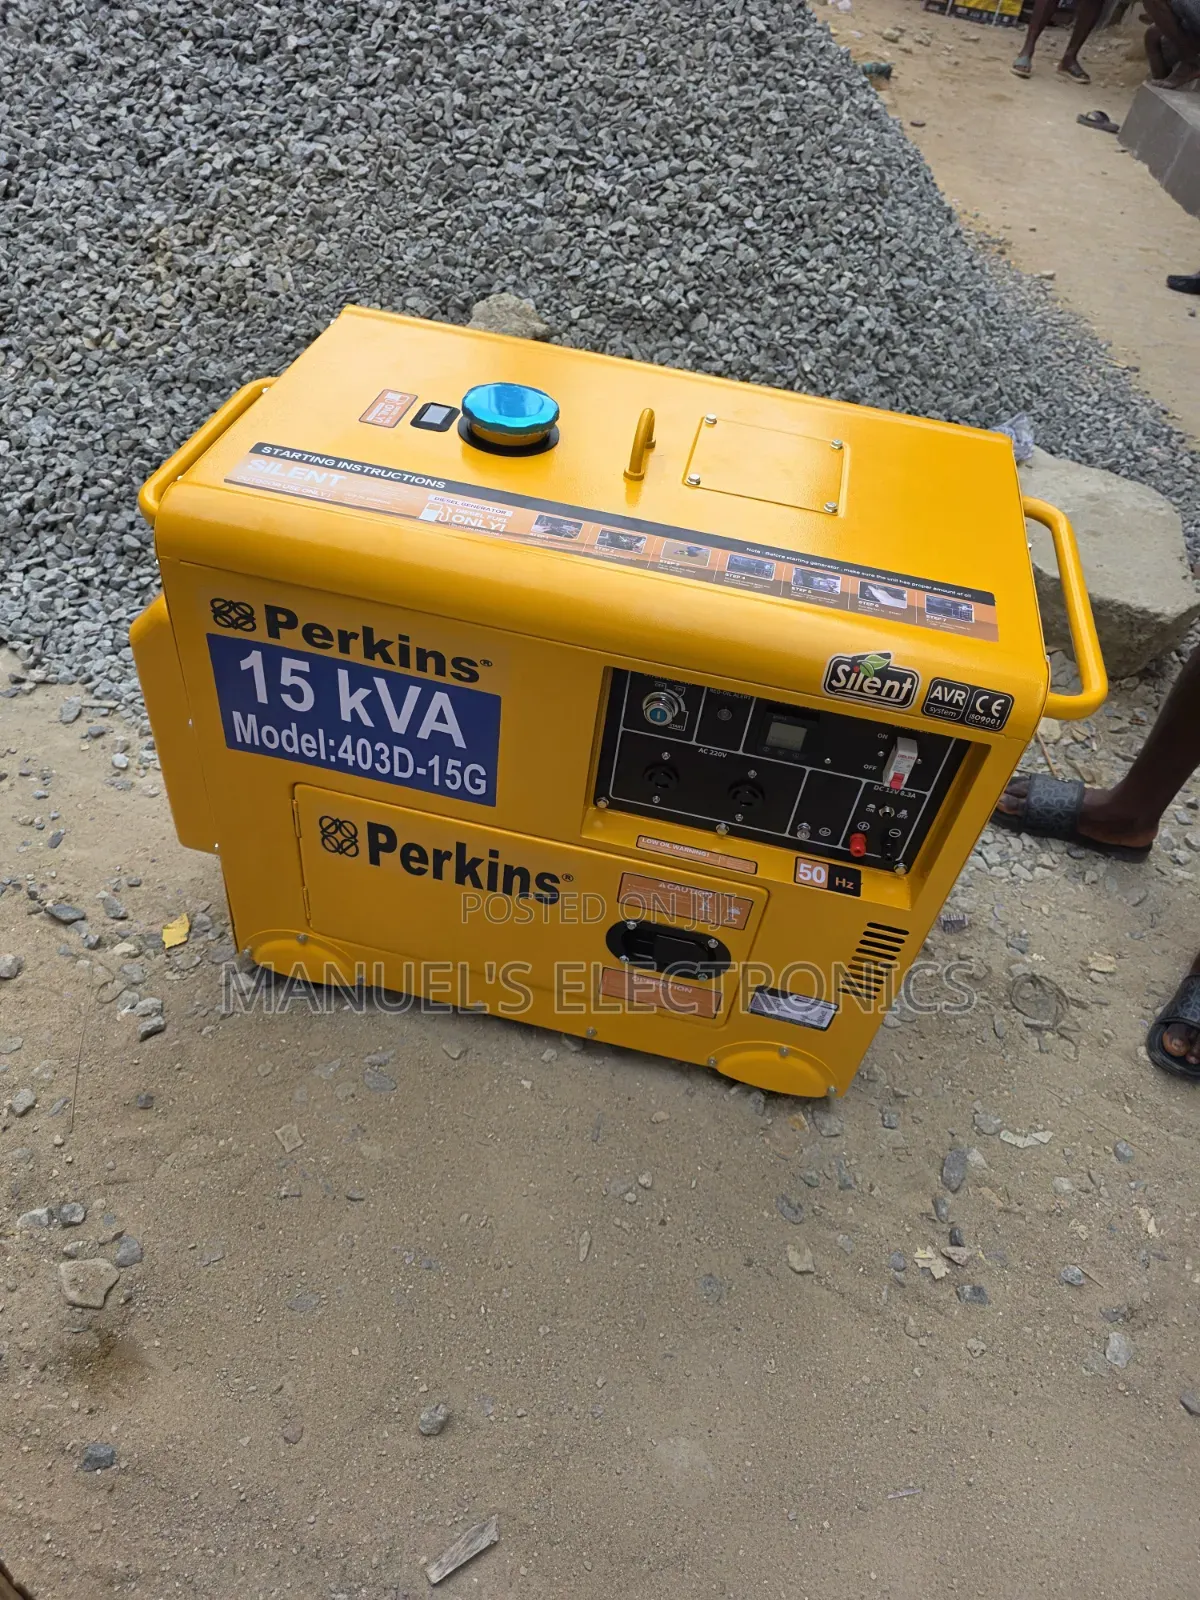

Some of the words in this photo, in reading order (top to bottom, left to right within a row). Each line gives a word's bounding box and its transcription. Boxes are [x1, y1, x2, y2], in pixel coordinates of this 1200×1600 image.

[247, 458, 347, 487] SILENT
[261, 446, 337, 466] STARTING
[337, 460, 446, 489] INSTRUCTIONS
[434, 496, 461, 506] DIESEL
[460, 502, 508, 515] GENERATOR
[451, 514, 508, 533] ONLY!
[594, 545, 611, 553] STEP
[831, 664, 913, 700] Silent
[239, 649, 315, 712] 15
[337, 669, 467, 749] kVA
[930, 685, 967, 706] AVR
[929, 705, 957, 718] system
[975, 695, 1005, 718] CE
[969, 713, 1001, 726] ISO9001
[877, 732, 889, 740] ON
[232, 711, 487, 796] Model:403D-15G
[709, 749, 728, 758] 220V
[885, 787, 899, 795] 12V
[900, 790, 916, 799] 8.3A
[641, 838, 660, 846] LOW
[672, 845, 710, 857] WARNING!
[798, 861, 826, 884] 50
[835, 875, 855, 891] Hz
